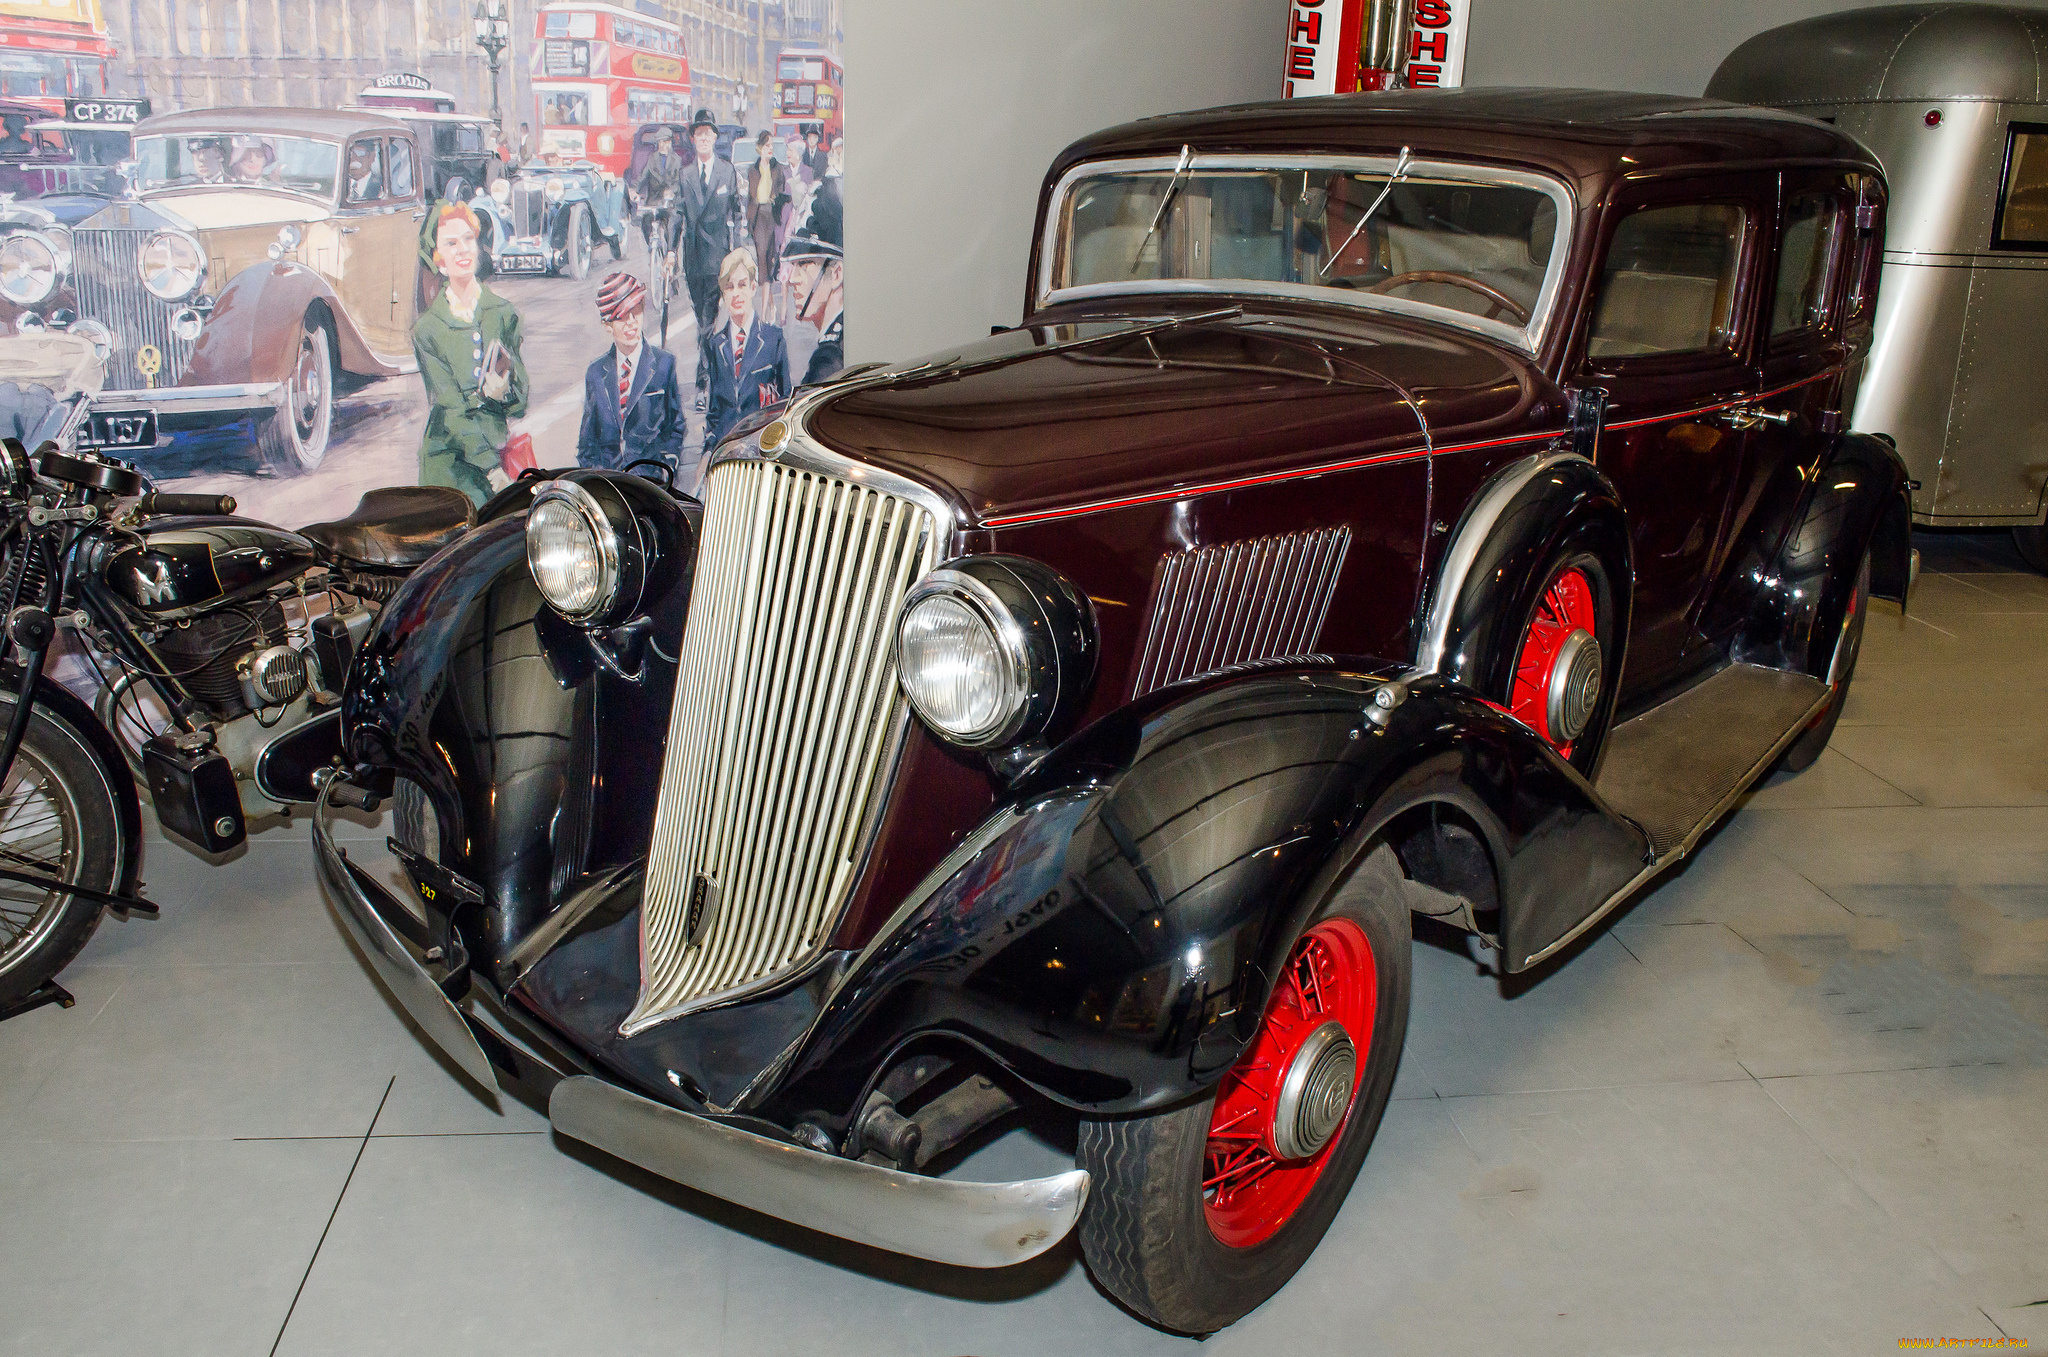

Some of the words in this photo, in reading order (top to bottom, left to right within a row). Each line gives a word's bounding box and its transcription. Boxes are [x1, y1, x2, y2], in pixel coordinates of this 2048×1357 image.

[376, 73, 429, 91] BROADS
[74, 103, 101, 120] CP
[104, 104, 138, 122] 374
[421, 882, 436, 900] 327
